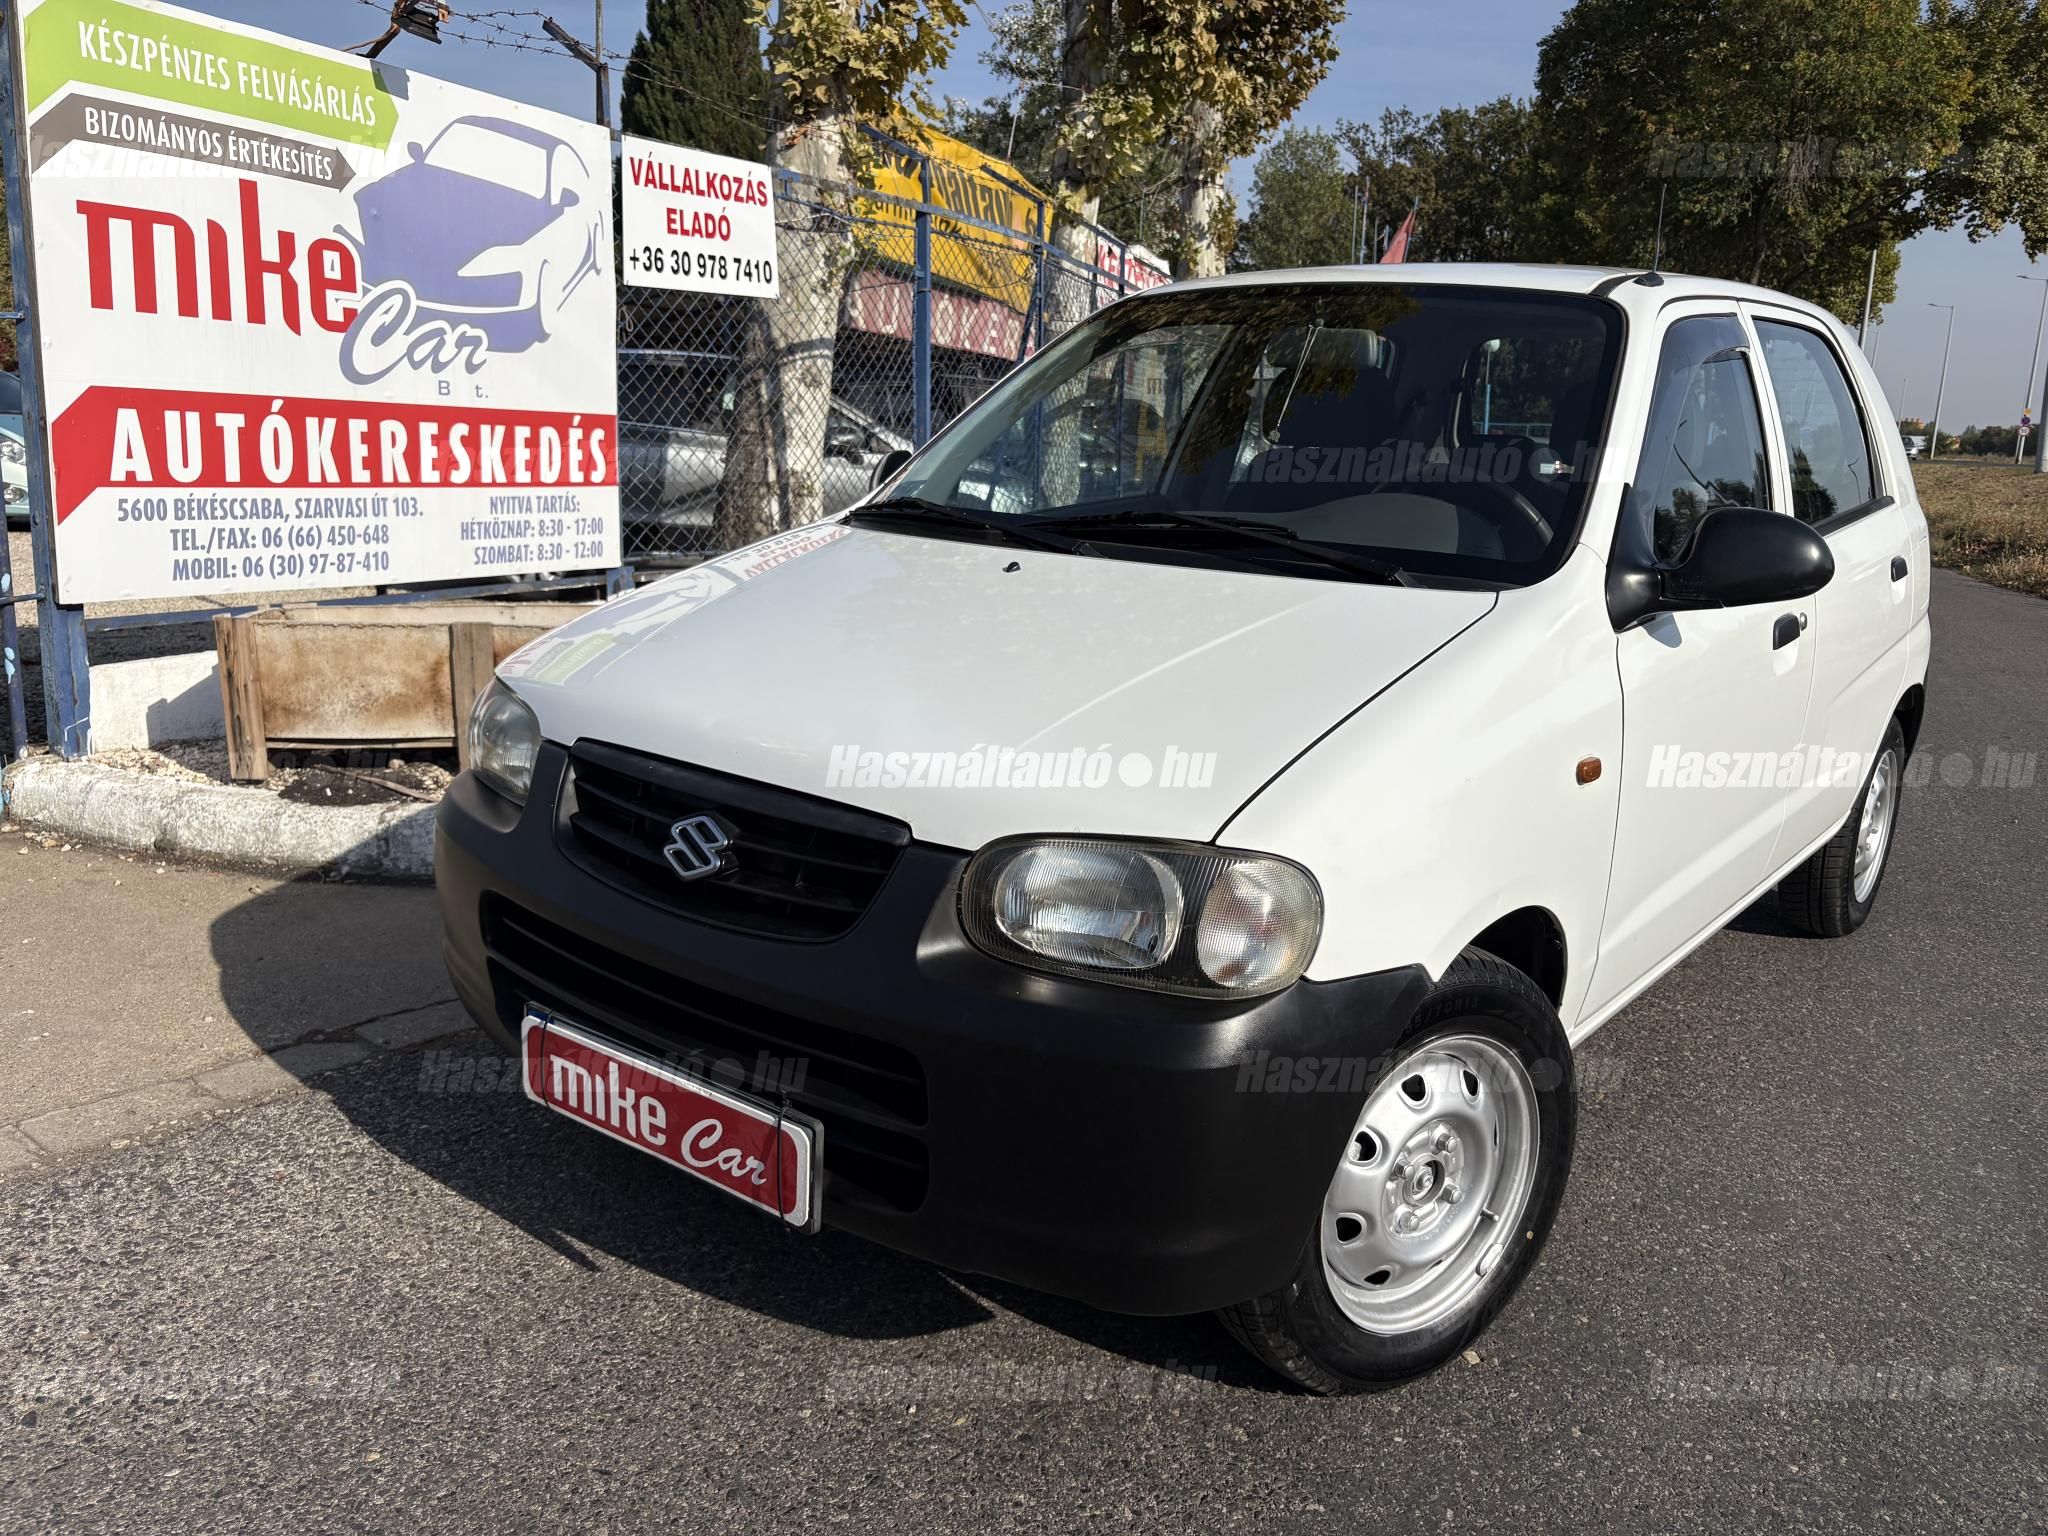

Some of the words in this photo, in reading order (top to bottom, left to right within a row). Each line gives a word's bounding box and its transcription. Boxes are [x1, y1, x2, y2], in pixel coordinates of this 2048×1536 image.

[78, 18, 231, 91] KÉSZPÉNZES
[237, 61, 376, 127] FELVÁSÁRLÁS
[84, 106, 223, 159] BIZOMÁNYOS
[228, 130, 333, 181] ÉRTÉKESÍTÉS
[629, 151, 768, 207] VÁLLALKOZÁS
[666, 206, 731, 242] ELADÓ
[76, 178, 359, 336] mike
[629, 246, 665, 273] +36
[670, 250, 691, 276] 30
[697, 253, 728, 280] 978
[733, 257, 773, 284] 7410
[338, 280, 488, 385] Car
[111, 399, 607, 485] AUTÓKERESKEDÉS
[117, 497, 168, 522] 5600
[173, 493, 290, 523] BÉKÉSCSABA,
[295, 496, 368, 519] SZARVASI
[371, 492, 389, 511] ÚT
[392, 496, 424, 518] 103.
[490, 496, 533, 515] NYITVA
[536, 491, 581, 513] TARTÁS:
[170, 526, 257, 555] TEL./FAX:
[261, 527, 283, 548] 06
[288, 525, 322, 550] (66)
[327, 524, 390, 547] 450-648
[460, 517, 535, 540] HÉTKÖZNAP:
[538, 519, 564, 538] 8:30
[574, 517, 604, 535] 17:00
[172, 557, 238, 581] MOBIL:
[242, 556, 264, 578] 06
[269, 553, 304, 579] (30)
[309, 551, 390, 575] 97-87-410
[474, 544, 534, 565] SZOMBAT:
[537, 543, 562, 561] 8:30
[574, 541, 604, 559] 12:00
[550, 1053, 667, 1147] mike
[681, 1118, 767, 1186] Car
